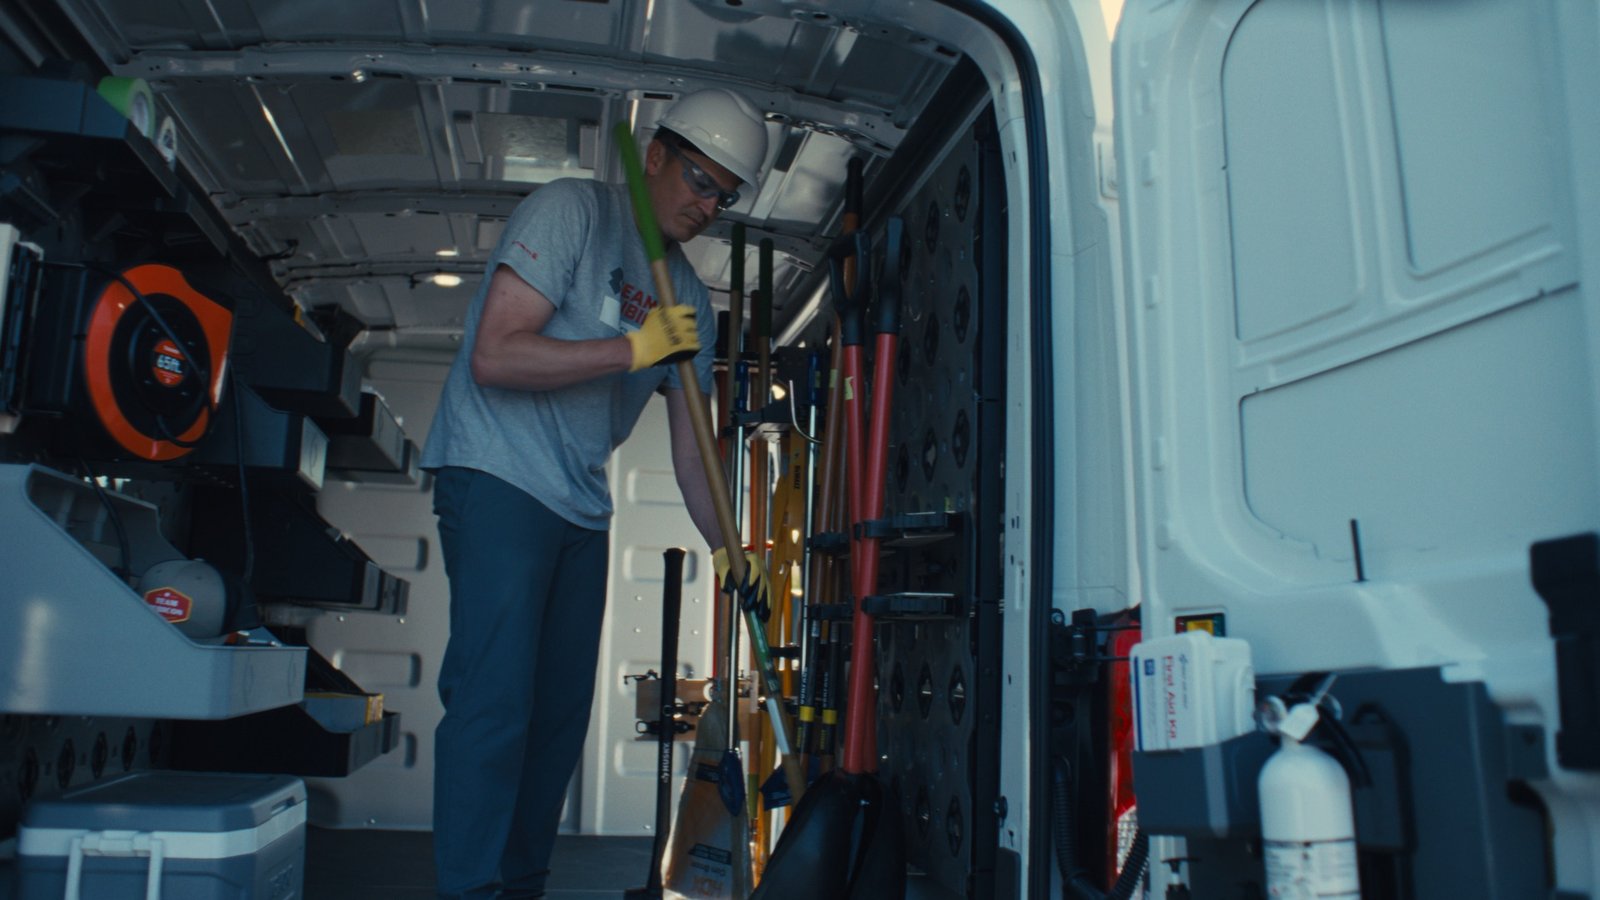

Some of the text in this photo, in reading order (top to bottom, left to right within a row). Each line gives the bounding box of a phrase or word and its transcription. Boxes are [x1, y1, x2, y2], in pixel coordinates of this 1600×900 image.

[621, 283, 658, 309] EAM
[1167, 690, 1177, 715] Aid
[661, 742, 671, 772] HUSKY
